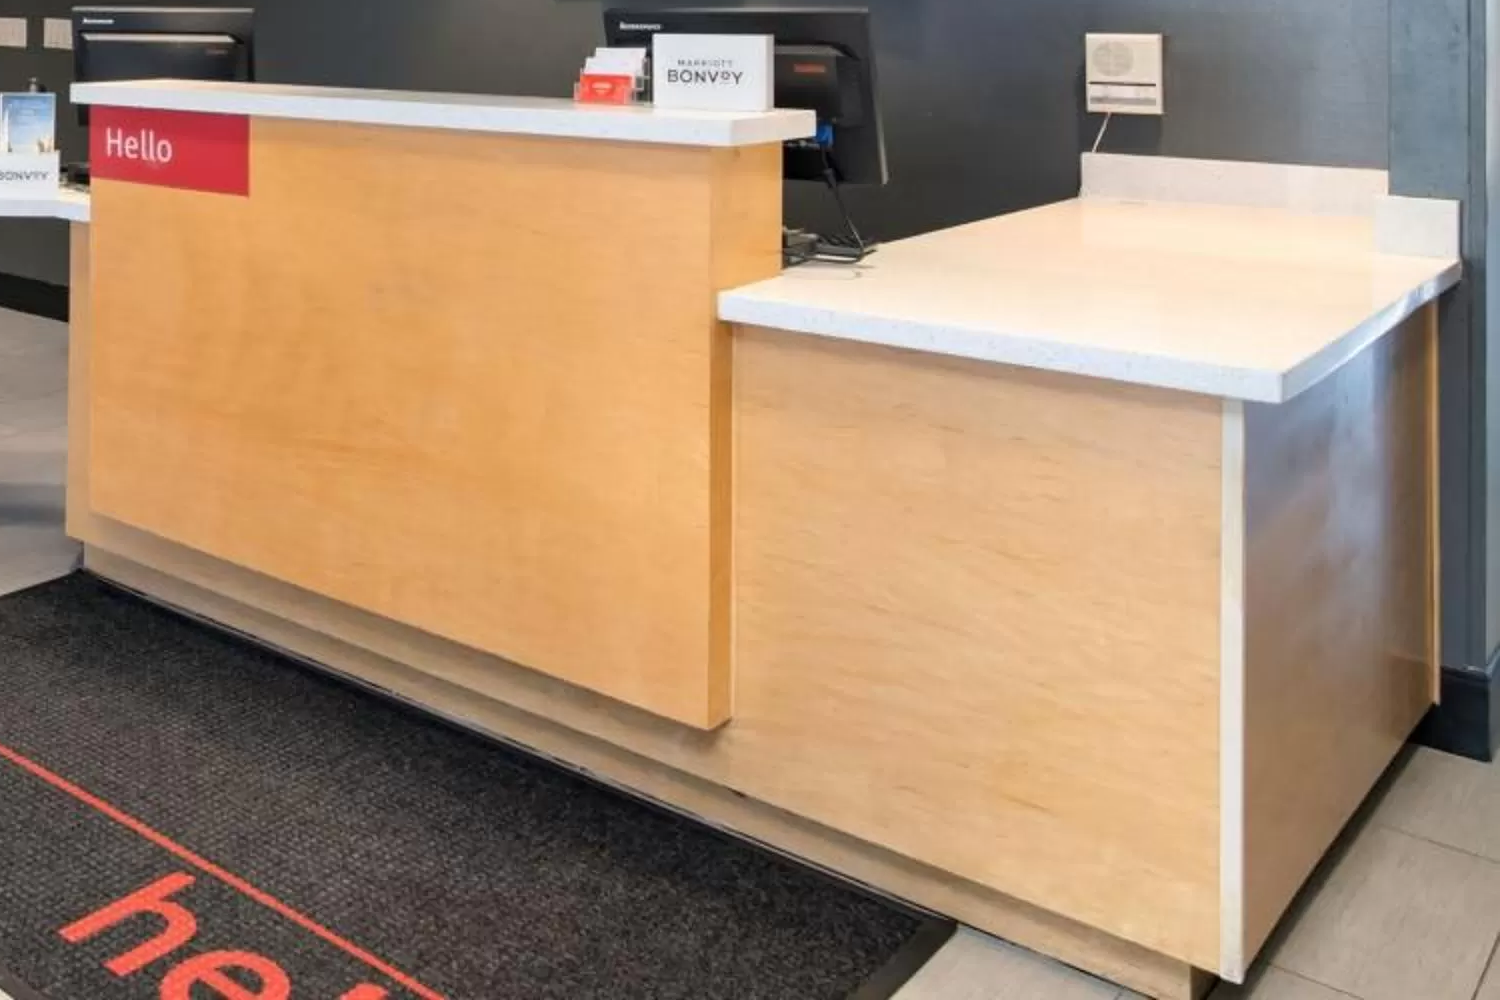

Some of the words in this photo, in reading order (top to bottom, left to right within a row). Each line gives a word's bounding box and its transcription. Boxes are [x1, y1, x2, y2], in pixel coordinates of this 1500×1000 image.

[667, 69, 743, 85] BONVOY
[106, 126, 173, 163] Hello
[58, 871, 388, 1000] he
